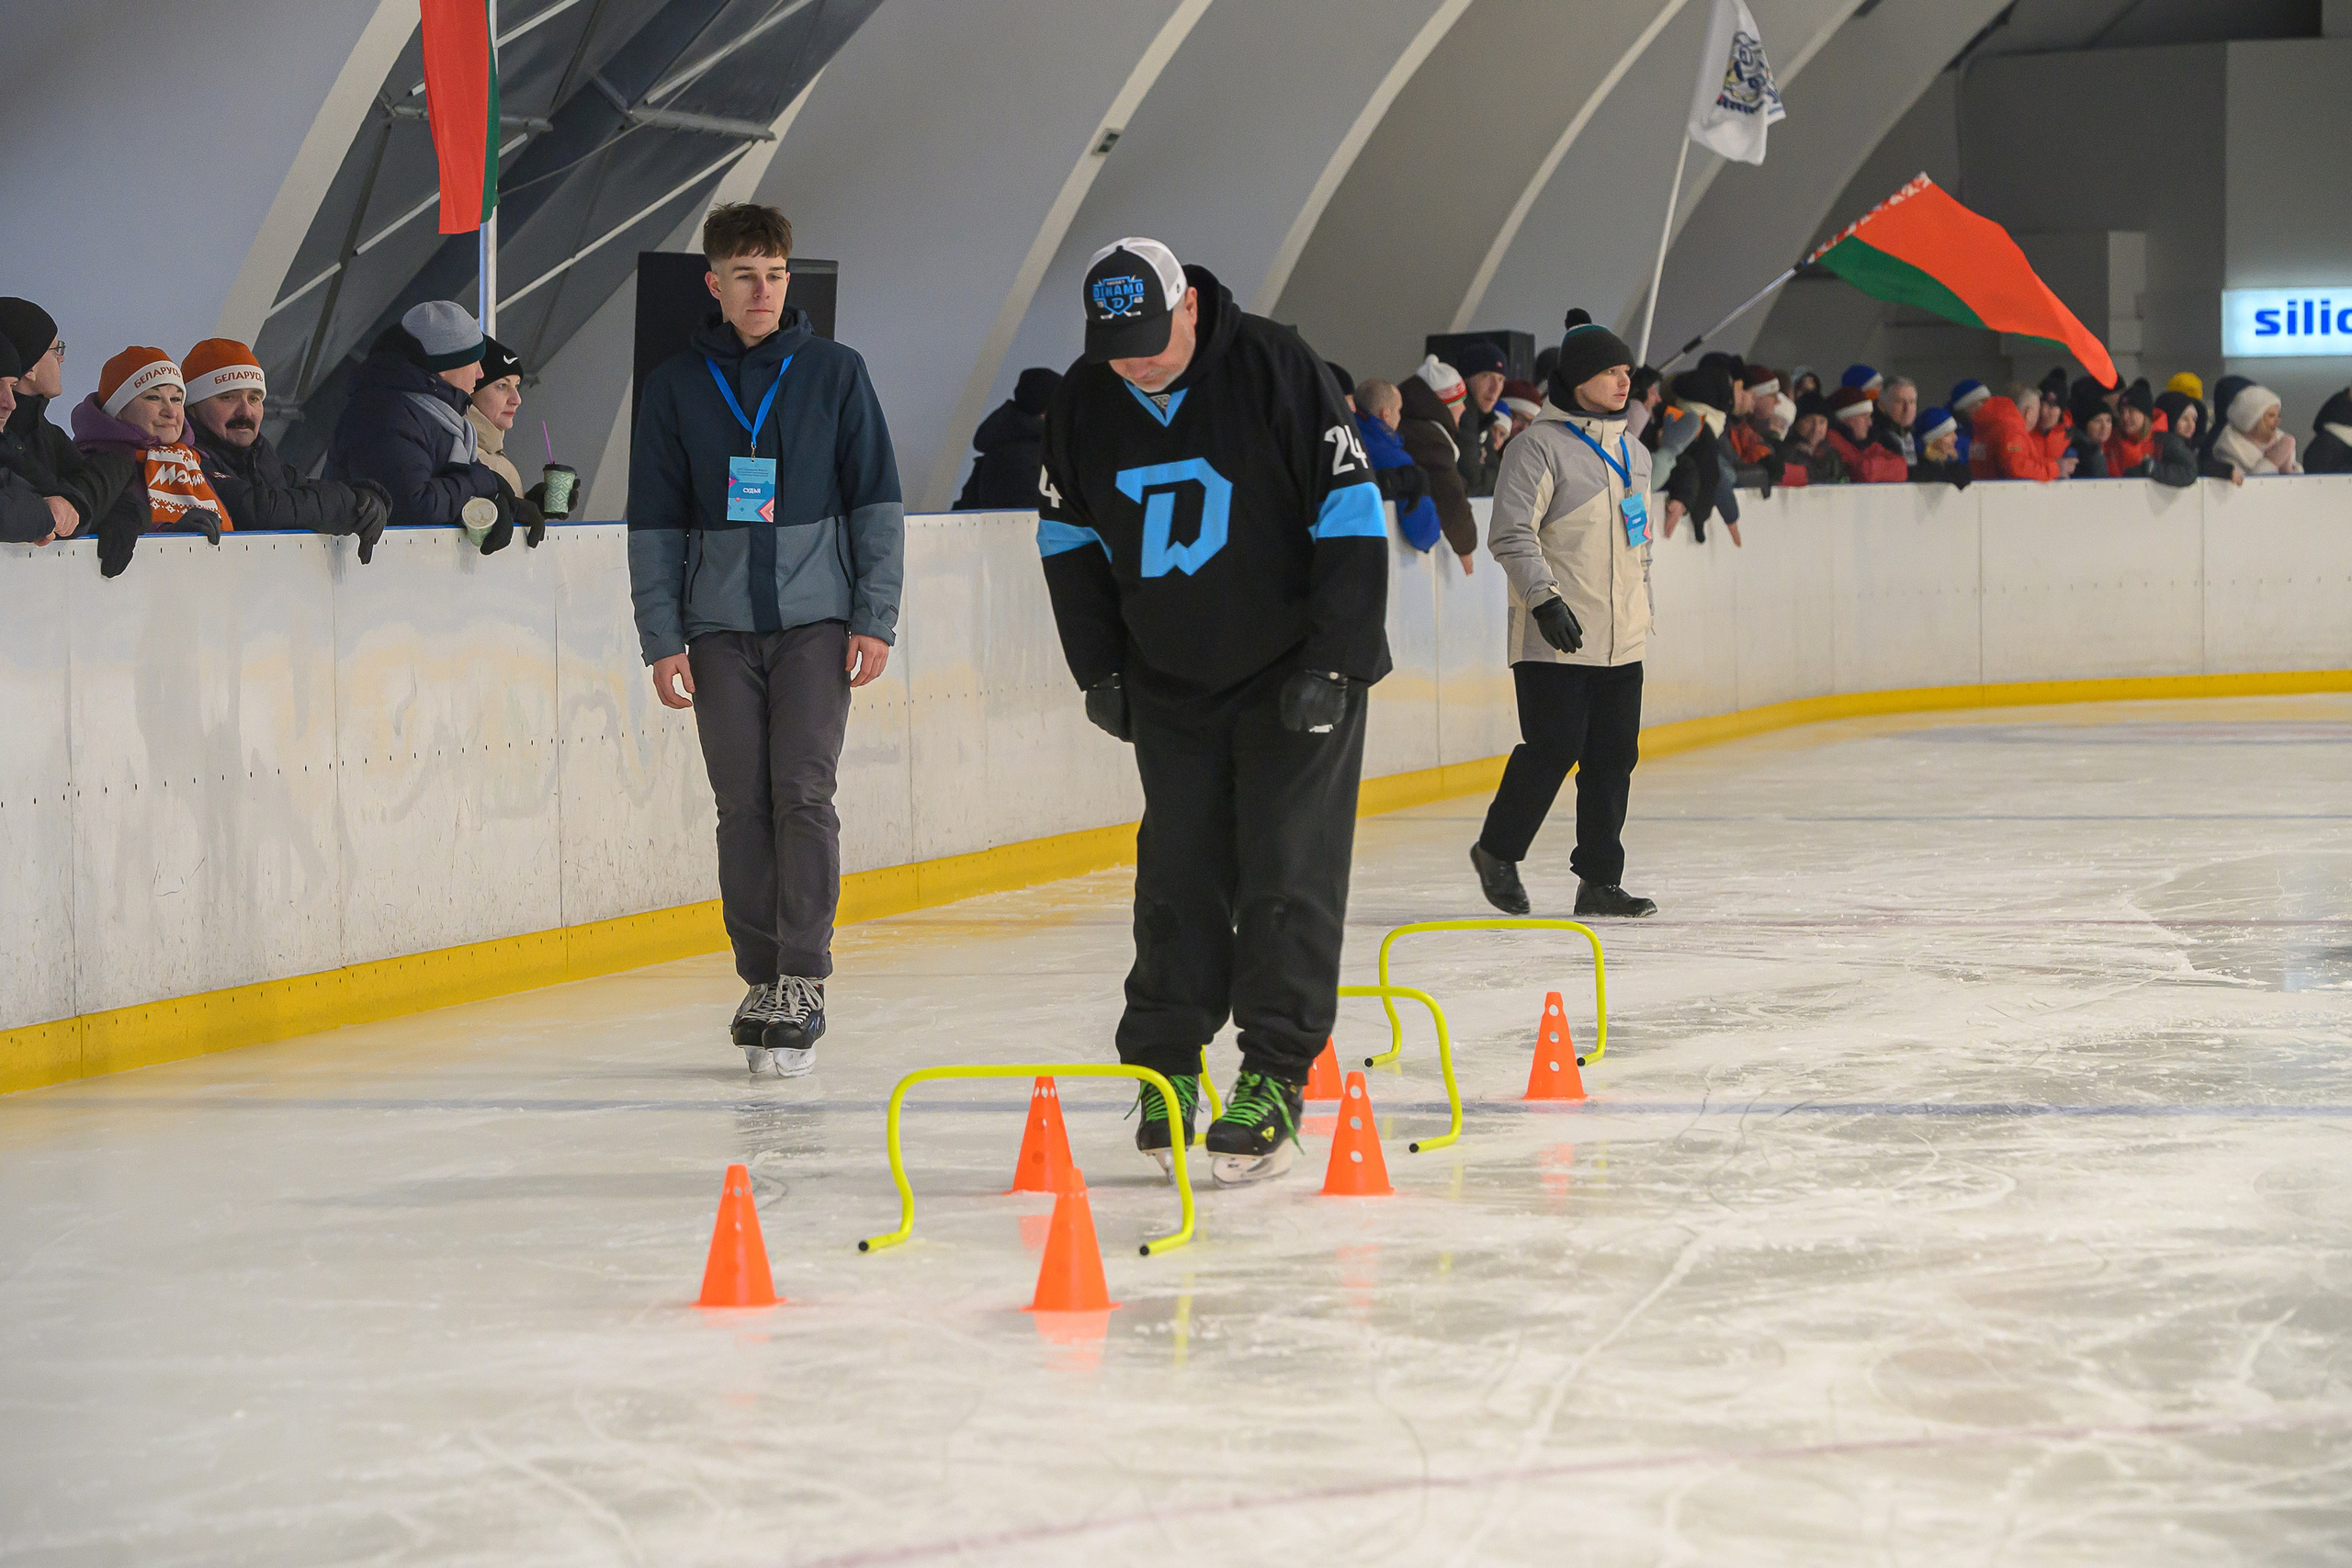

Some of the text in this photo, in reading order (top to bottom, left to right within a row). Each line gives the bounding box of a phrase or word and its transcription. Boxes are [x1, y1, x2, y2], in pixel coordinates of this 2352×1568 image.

[1093, 282, 1144, 299] DINAMO
[133, 366, 181, 389] БЕЛАРУСЬ
[214, 370, 264, 385] БЕЛАРУСЬ
[1324, 424, 1369, 476] 24
